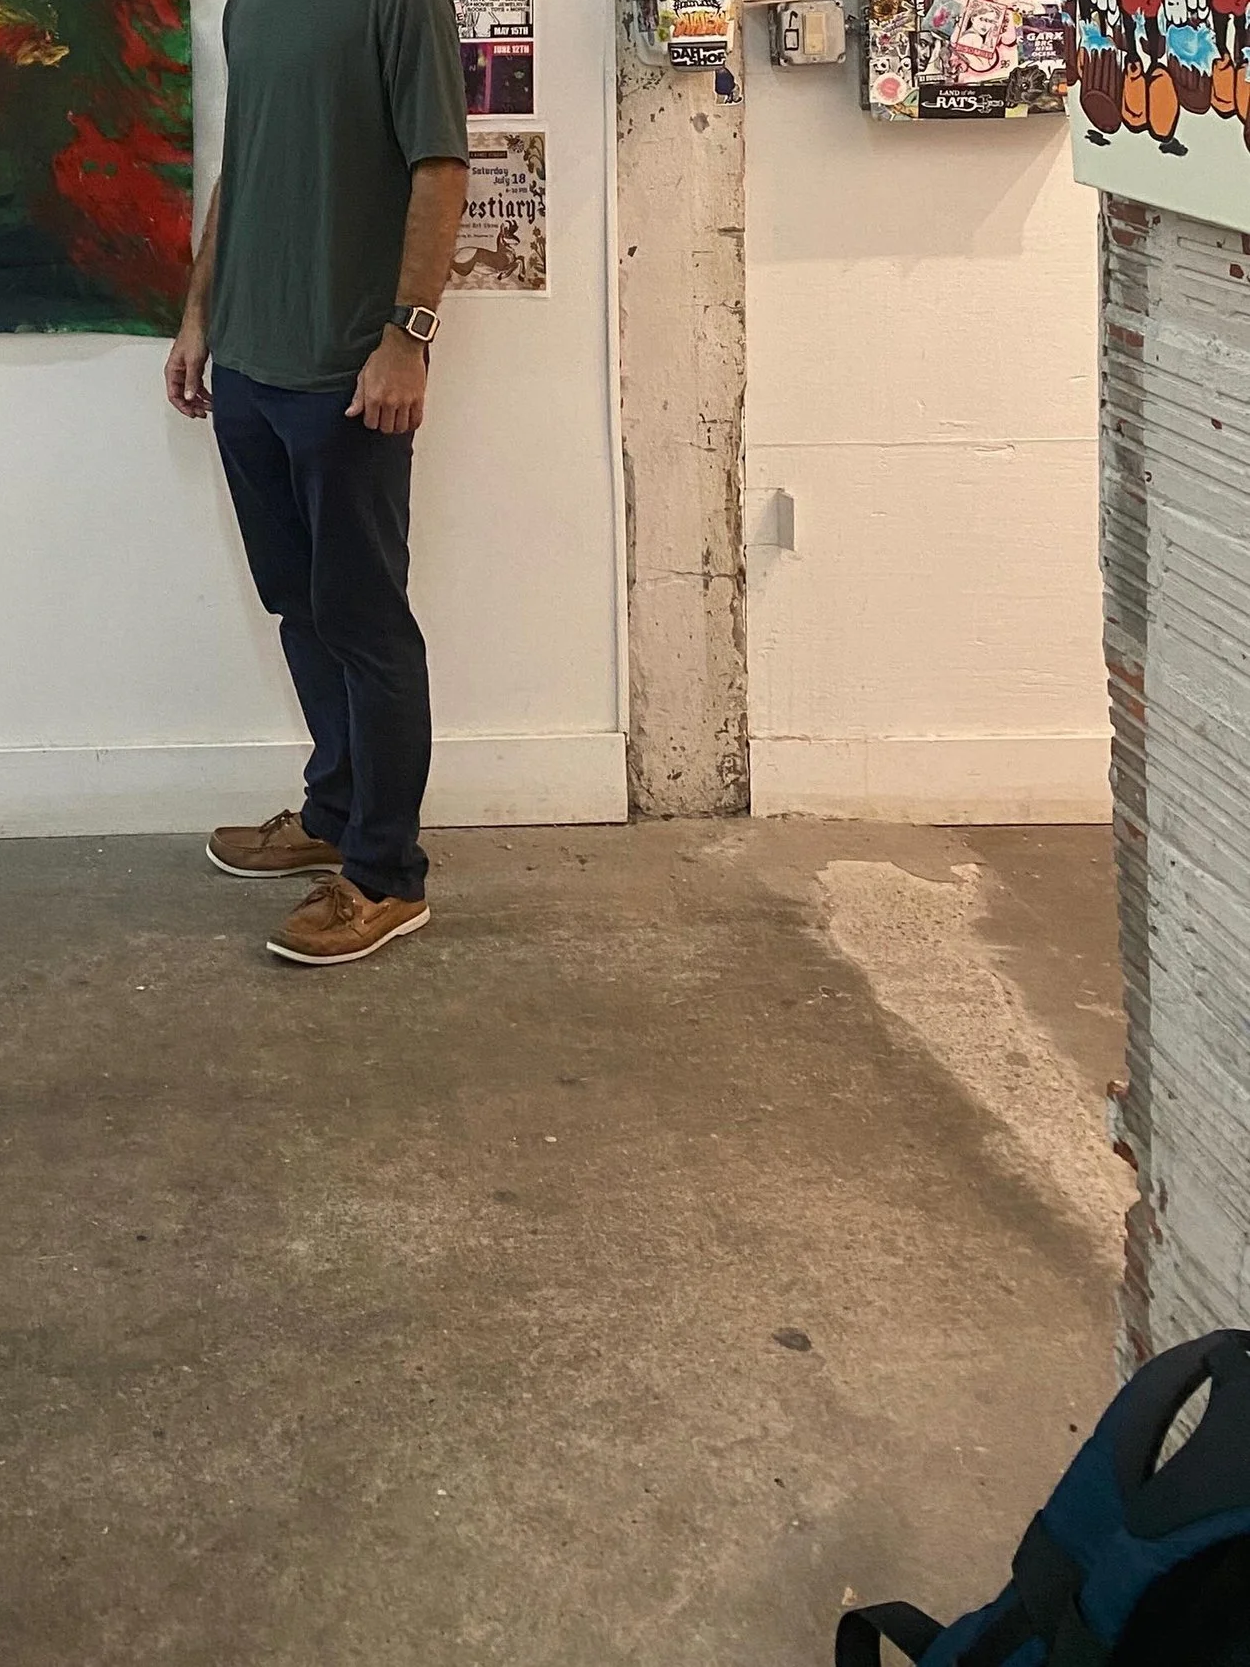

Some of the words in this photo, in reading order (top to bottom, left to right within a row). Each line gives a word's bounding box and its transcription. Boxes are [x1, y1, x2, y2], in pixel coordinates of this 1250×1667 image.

[494, 27, 509, 35] MAY
[511, 26, 529, 35] 15TH
[493, 45, 510, 54] JUNE
[512, 45, 530, 54] 12TH
[936, 97, 977, 110] RATS
[472, 167, 509, 176] Saturday
[493, 176, 510, 186] July
[512, 173, 526, 184] 18
[461, 193, 536, 225] estiary
